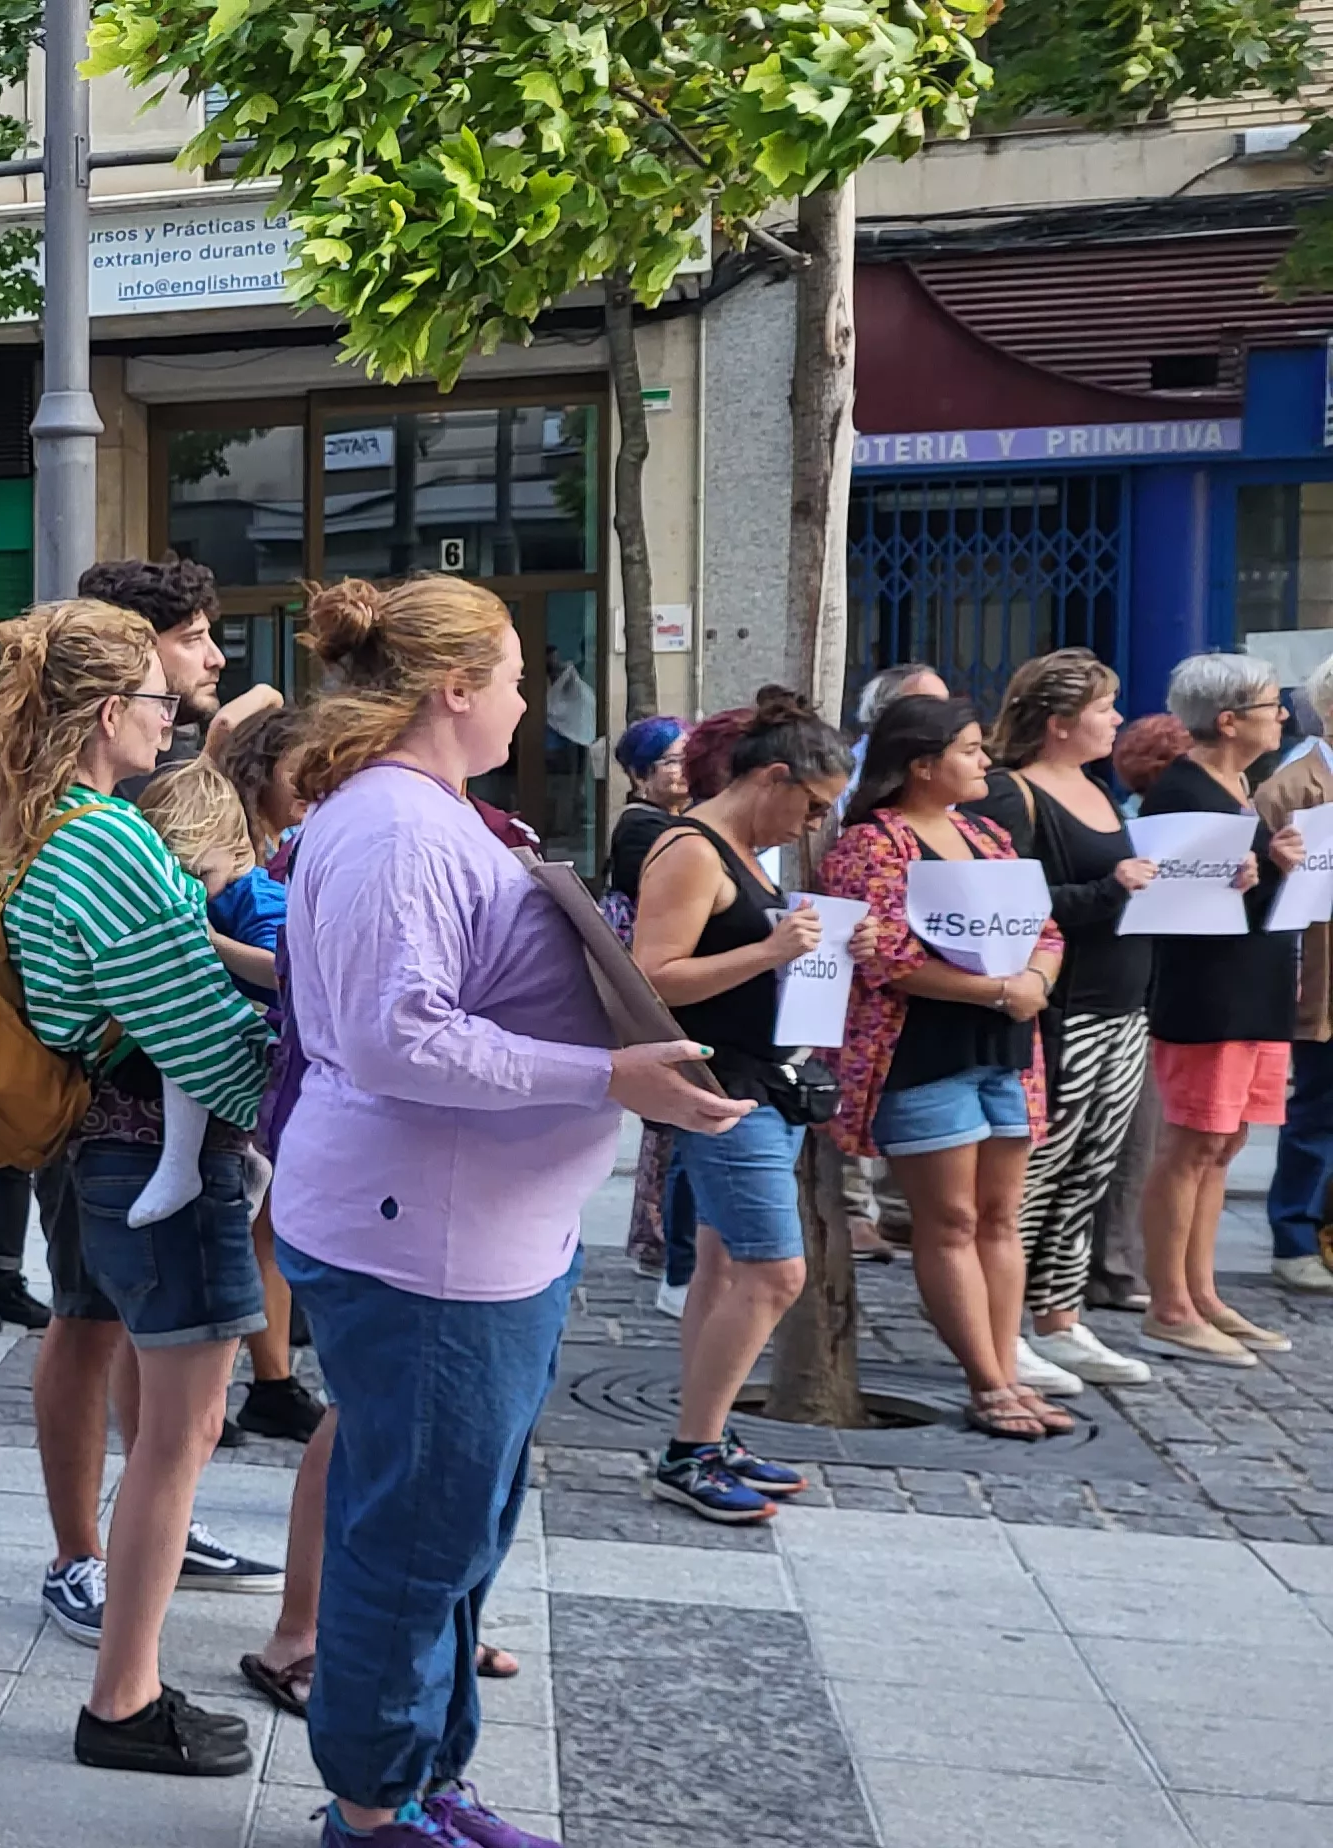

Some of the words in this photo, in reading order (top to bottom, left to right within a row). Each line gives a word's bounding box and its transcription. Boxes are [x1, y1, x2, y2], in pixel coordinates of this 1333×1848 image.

[88, 228, 138, 244] ursos
[145, 226, 155, 243] y
[162, 217, 256, 238] Prácticas
[93, 248, 192, 269] extranjero
[199, 239, 276, 260] durante
[853, 433, 968, 463] OTERIA
[997, 433, 1018, 457] Y
[1046, 421, 1224, 456] PRIMITIVA
[445, 541, 460, 567] 6
